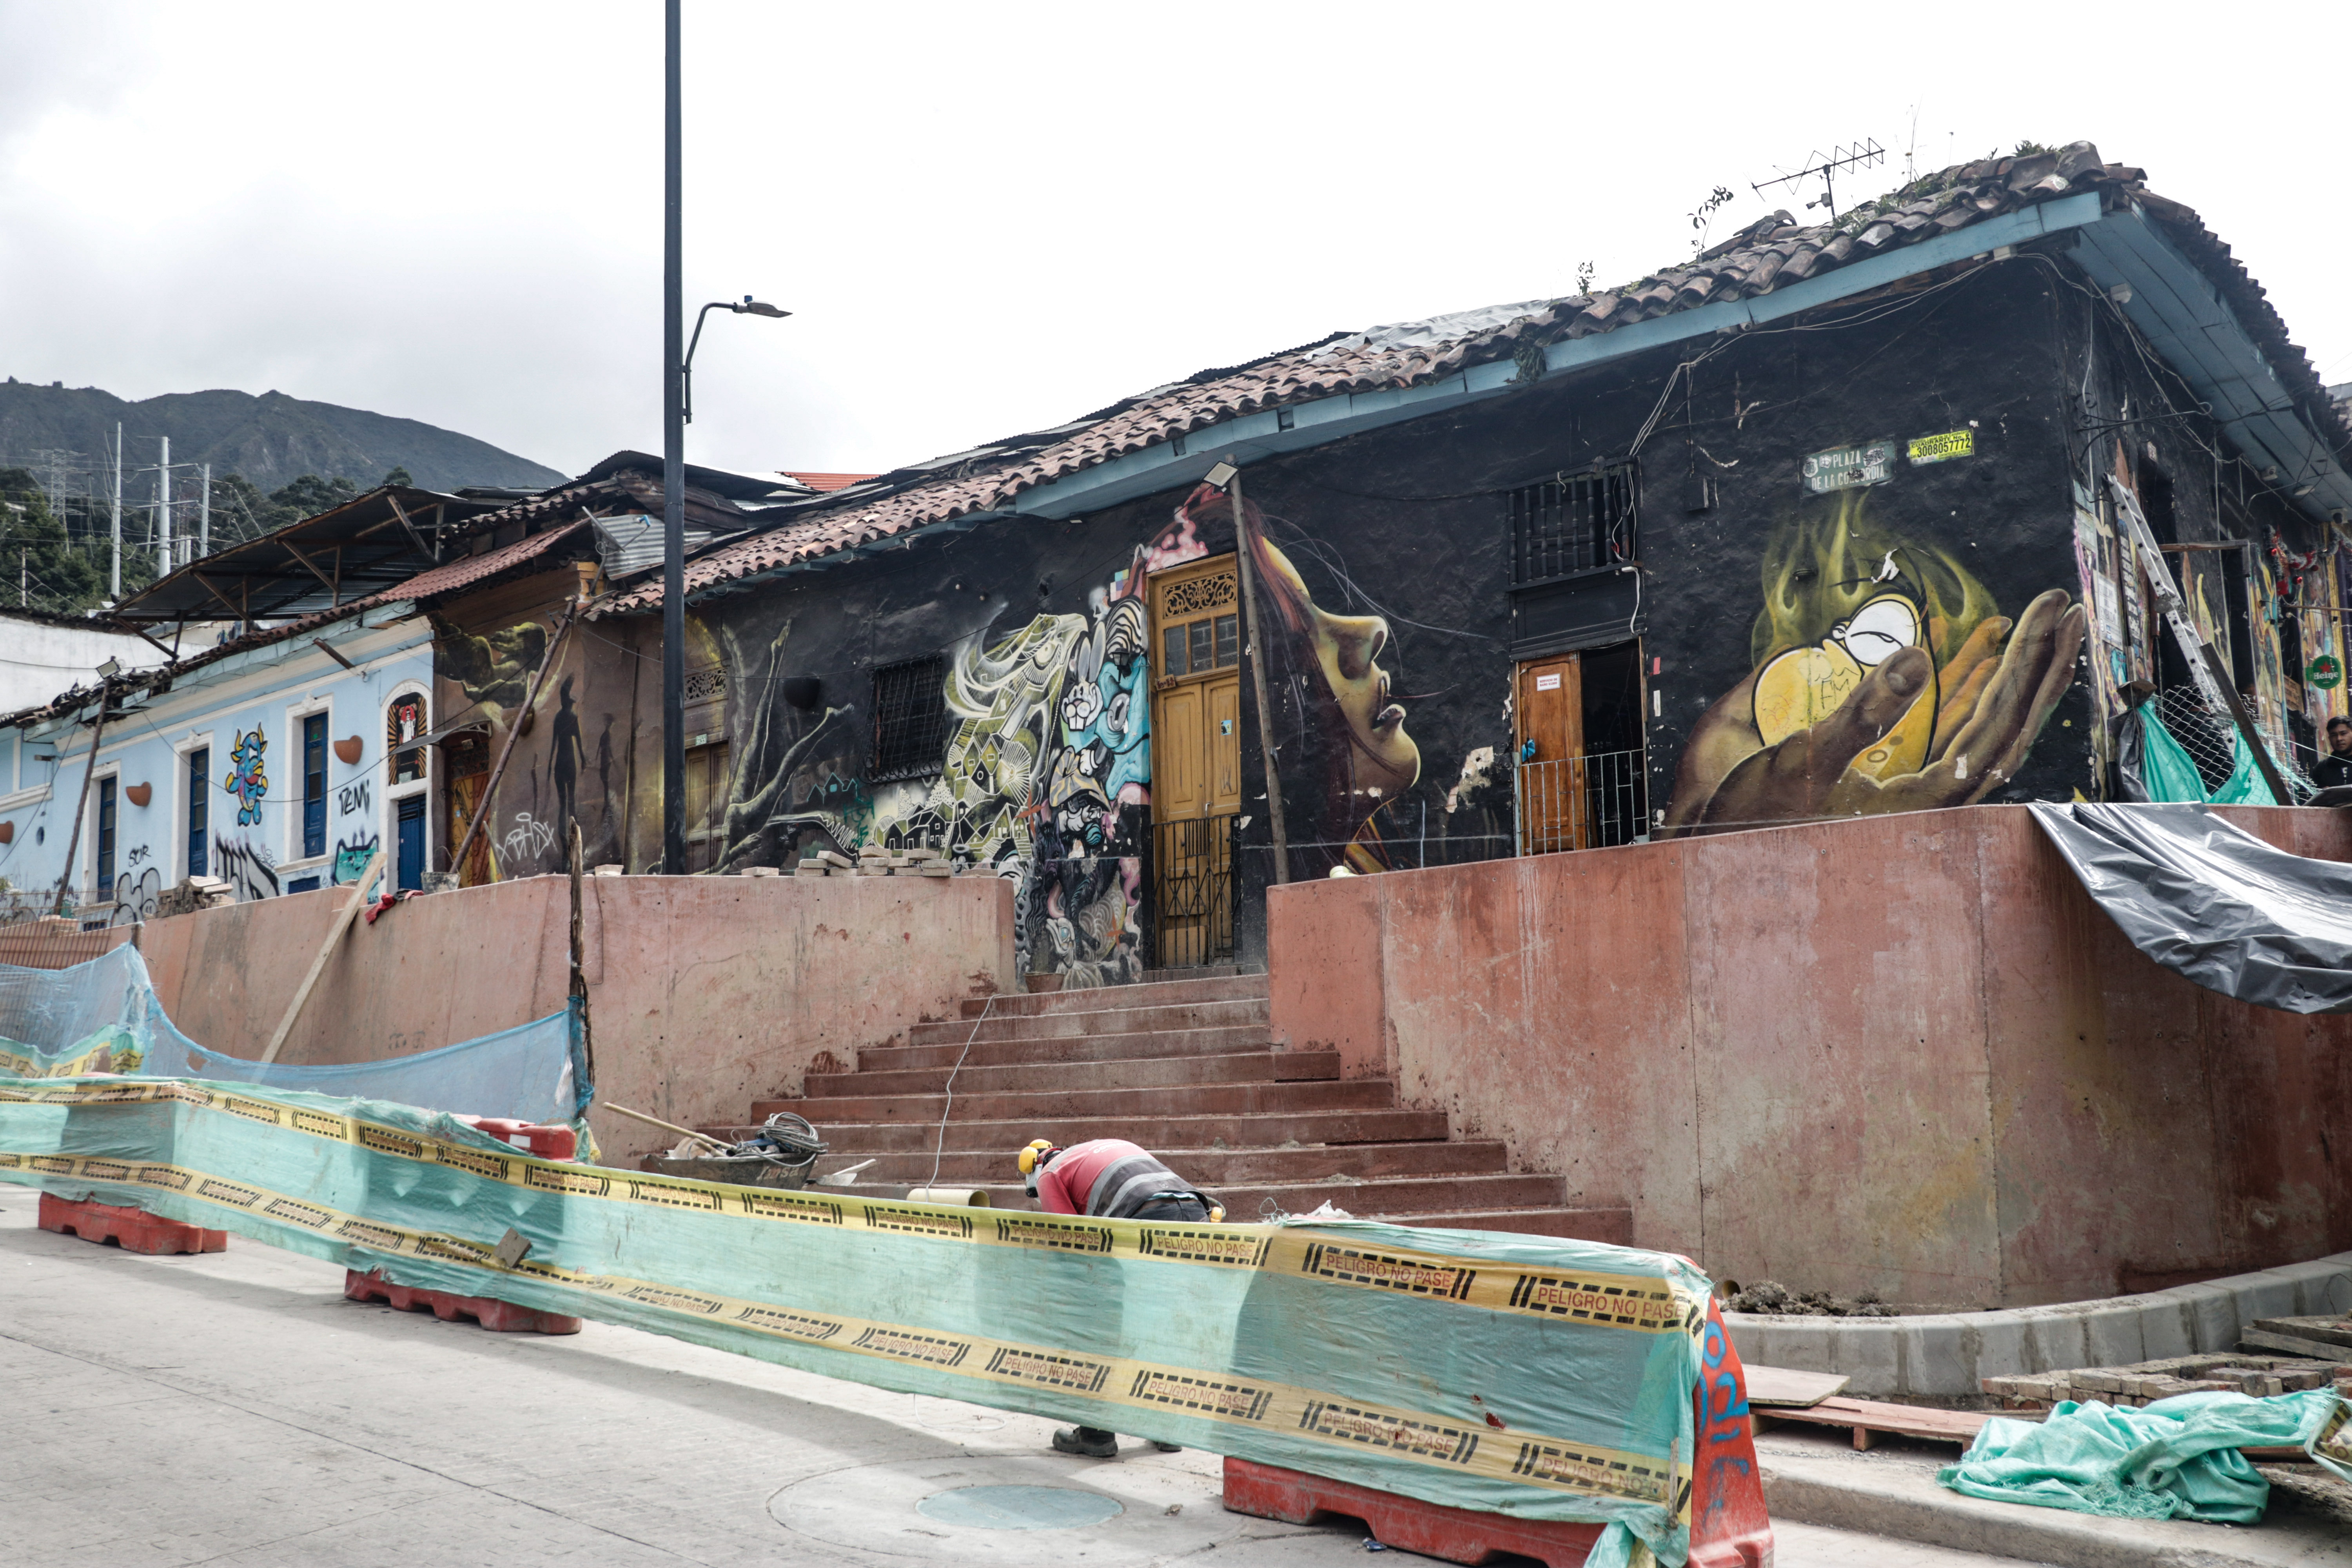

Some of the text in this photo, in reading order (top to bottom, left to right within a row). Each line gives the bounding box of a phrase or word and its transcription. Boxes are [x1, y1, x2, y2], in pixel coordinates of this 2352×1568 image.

[1912, 437, 1951, 448] CUADRANTE
[1917, 437, 1971, 457] 3008057772
[1833, 450, 1860, 468] PLAZA
[1811, 476, 1822, 490] DE
[1824, 474, 1835, 488] LA
[534, 1171, 599, 1190] PELIGRO NO PASE
[643, 1185, 712, 1204] PELIGRO NO PASE
[755, 1200, 830, 1218] PELIGRO NO PASE
[880, 1212, 960, 1230] PELIGRO NO PASE
[1014, 1225, 1100, 1245] PELIGRO NO PASE
[1158, 1237, 1253, 1258] PELIGRO NO PASE
[1326, 1254, 1452, 1288] PELIGRO NO PASE
[670, 1298, 684, 1308] NO
[1537, 1287, 1685, 1319] PELIGRO NO PASE
[872, 1336, 953, 1360] PELIGRO NO PASE
[1005, 1356, 1092, 1384] PELIGRO NO PASE
[1149, 1381, 1249, 1411] PELIGRO NO PASE
[1324, 1413, 1455, 1454] PELIGRO NO PASE
[1541, 1456, 1613, 1485] PELIGRO
[1618, 1474, 1643, 1490] NO
